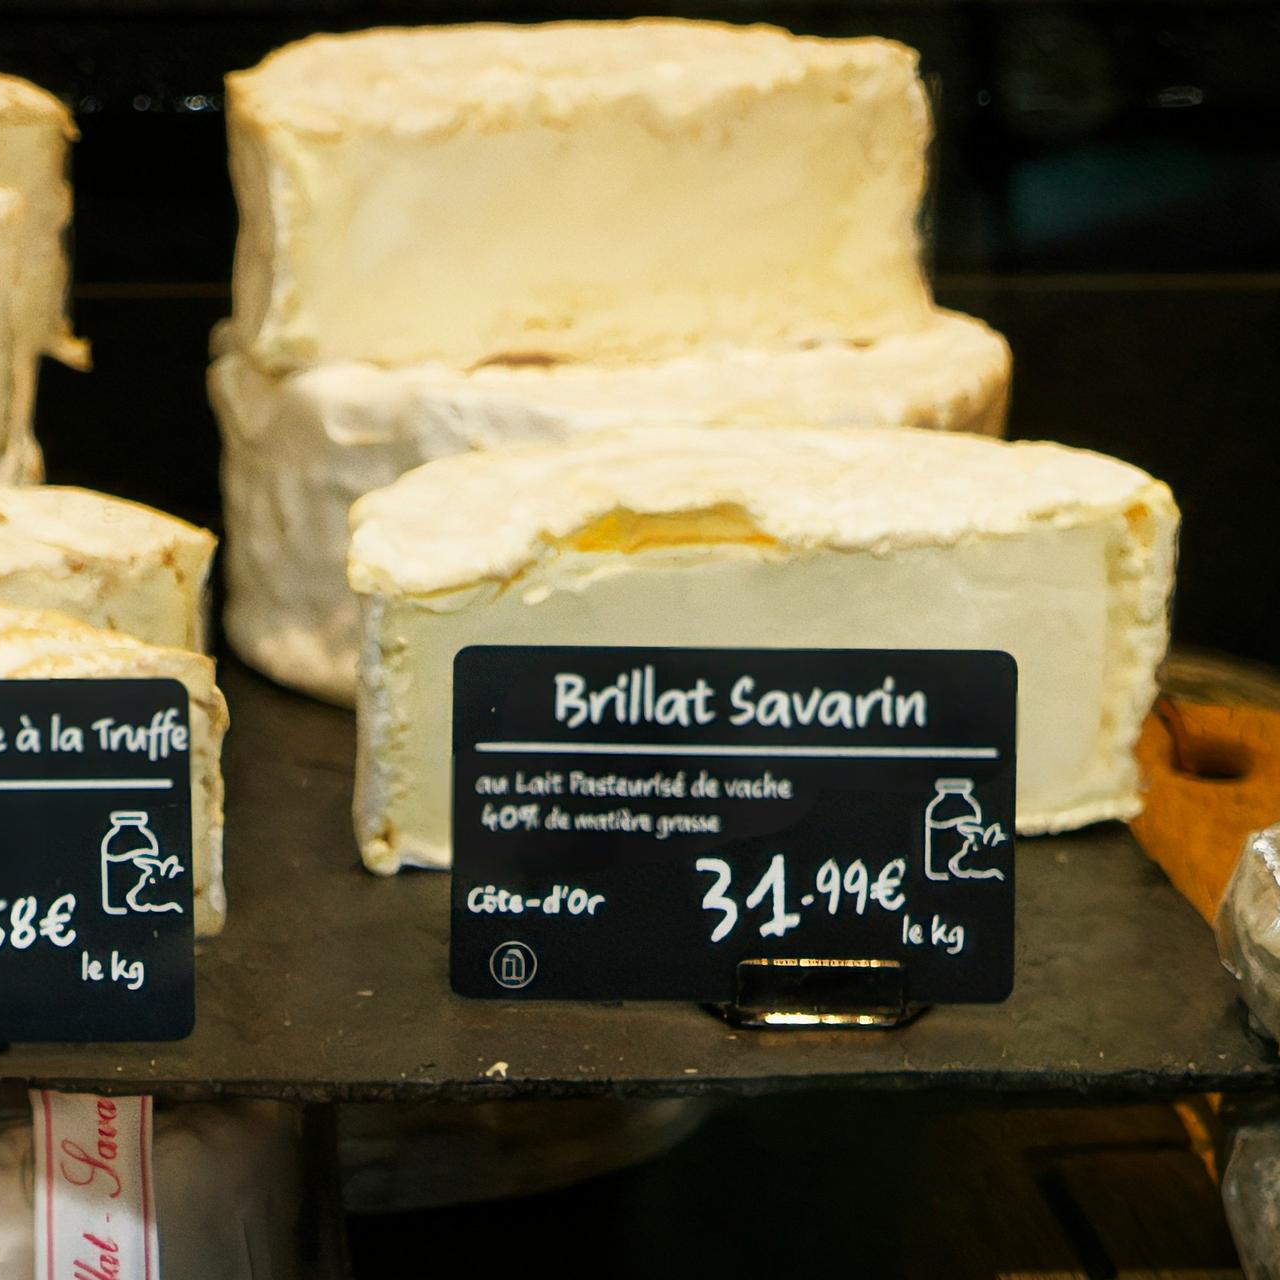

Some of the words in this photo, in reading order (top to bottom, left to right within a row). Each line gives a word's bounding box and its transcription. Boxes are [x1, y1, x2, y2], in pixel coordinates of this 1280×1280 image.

[555, 665, 716, 728] Brillat
[729, 676, 928, 728] Savarin
[16, 715, 42, 751] à
[50, 715, 83, 751] la
[93, 709, 188, 761] Truffe
[476, 777, 507, 795] au
[516, 772, 562, 795] Lait
[569, 770, 686, 798] Pasteurisé
[692, 773, 719, 798] de
[724, 776, 792, 799] vache
[482, 803, 538, 830] 40%
[545, 807, 569, 830] de
[574, 806, 652, 832] matière
[656, 811, 720, 838] grasse
[468, 886, 604, 915] Côte-d'Or
[695, 854, 907, 941] 31.99€
[902, 915, 924, 944] le
[931, 915, 964, 953] kg
[82, 951, 104, 980] le
[112, 951, 144, 990] kg
[60, 1097, 121, 1198] Sava
